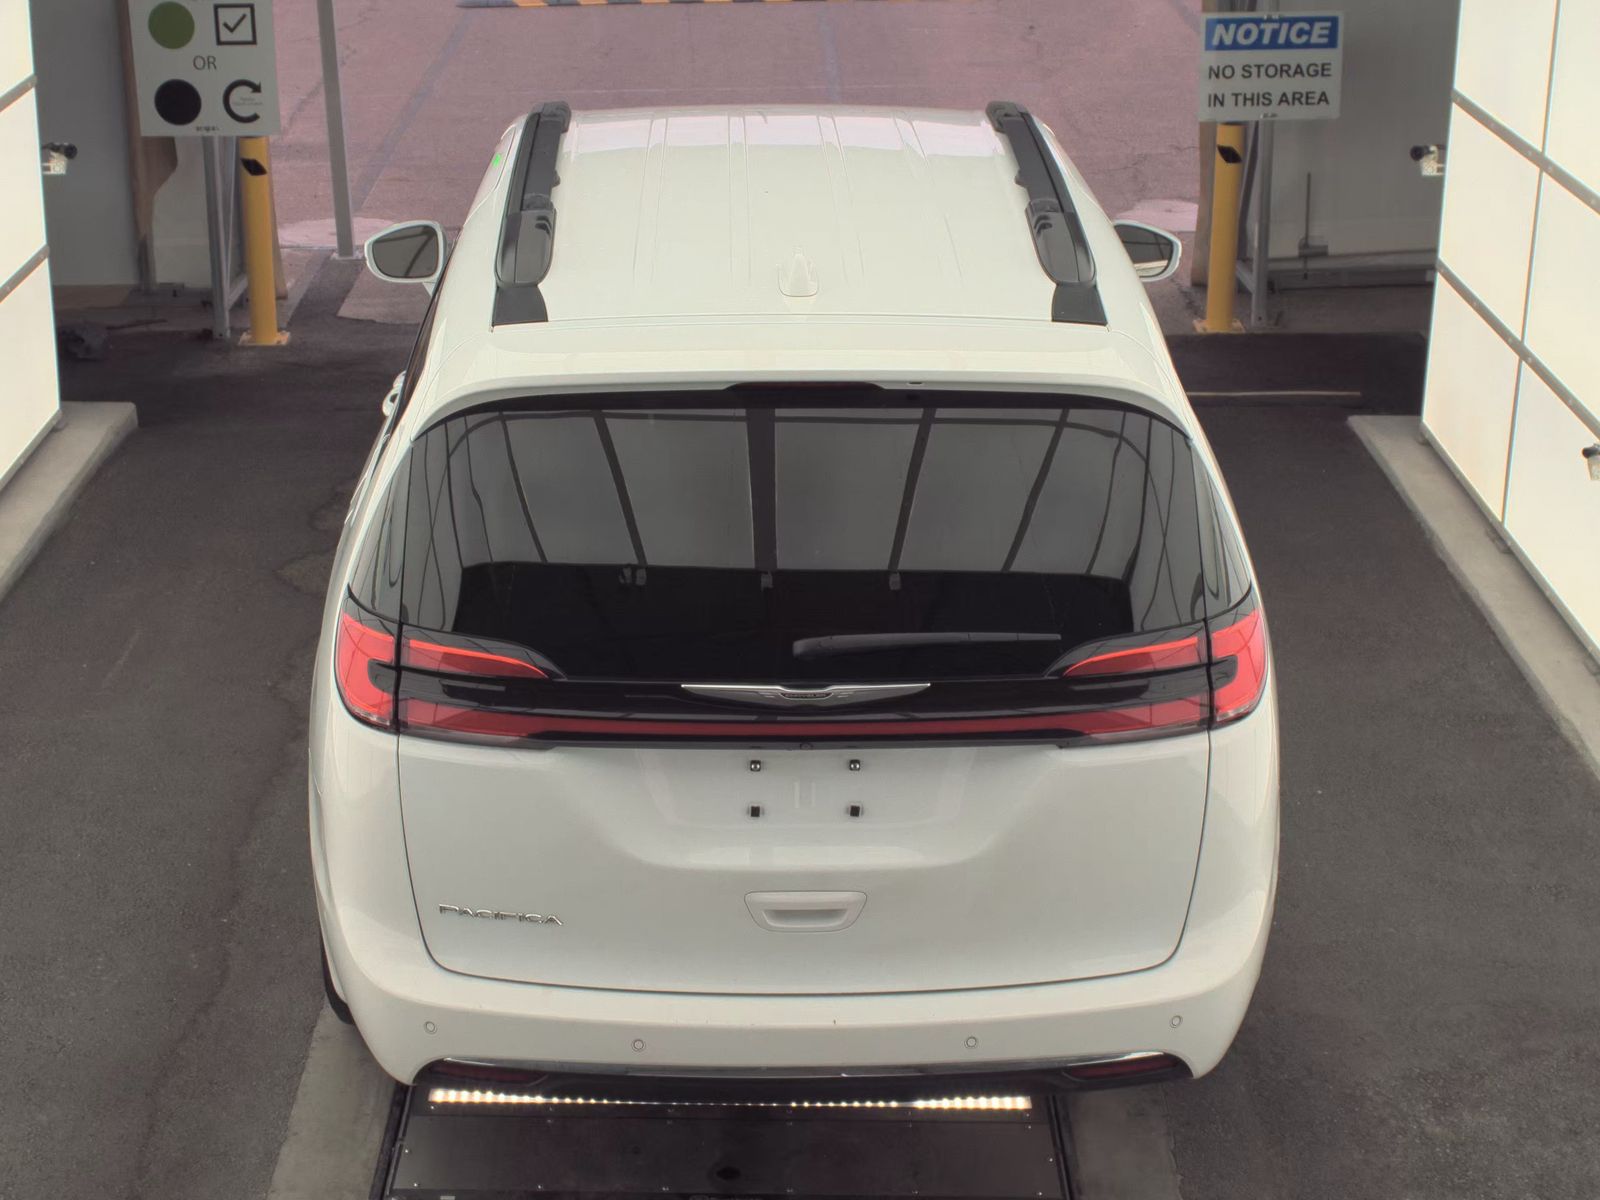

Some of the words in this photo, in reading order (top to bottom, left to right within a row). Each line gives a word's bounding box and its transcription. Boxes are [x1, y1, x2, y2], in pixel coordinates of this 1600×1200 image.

[1212, 22, 1331, 45] NOTICE
[192, 55, 217, 70] OR
[1208, 65, 1235, 79] NO
[1241, 63, 1332, 78] STORAGE
[1208, 93, 1225, 107] IN
[1231, 92, 1273, 106] THIS
[1277, 91, 1329, 106] AREA
[438, 903, 563, 926] PACIFICA
